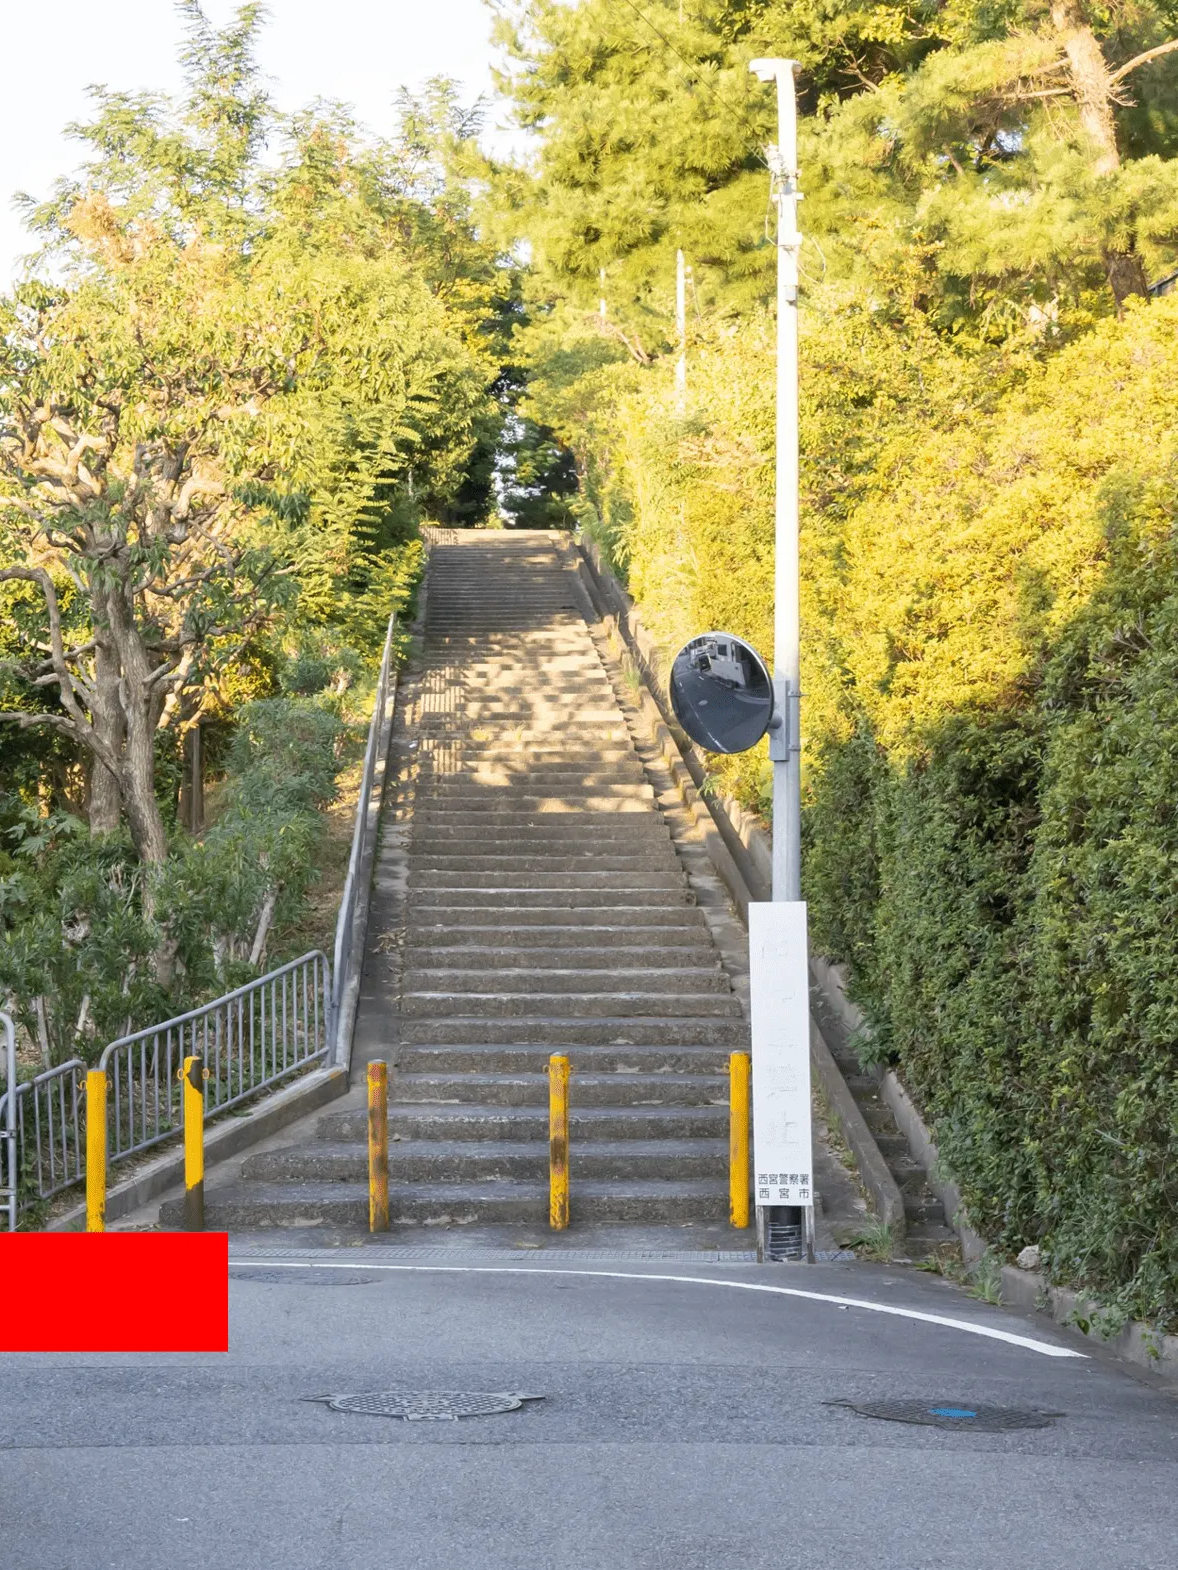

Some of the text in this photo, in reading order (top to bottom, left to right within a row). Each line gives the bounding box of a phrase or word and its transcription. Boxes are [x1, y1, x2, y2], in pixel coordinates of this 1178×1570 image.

[758, 1173, 810, 1185] 西宮警察署
[758, 1187, 810, 1199] 西宮市
